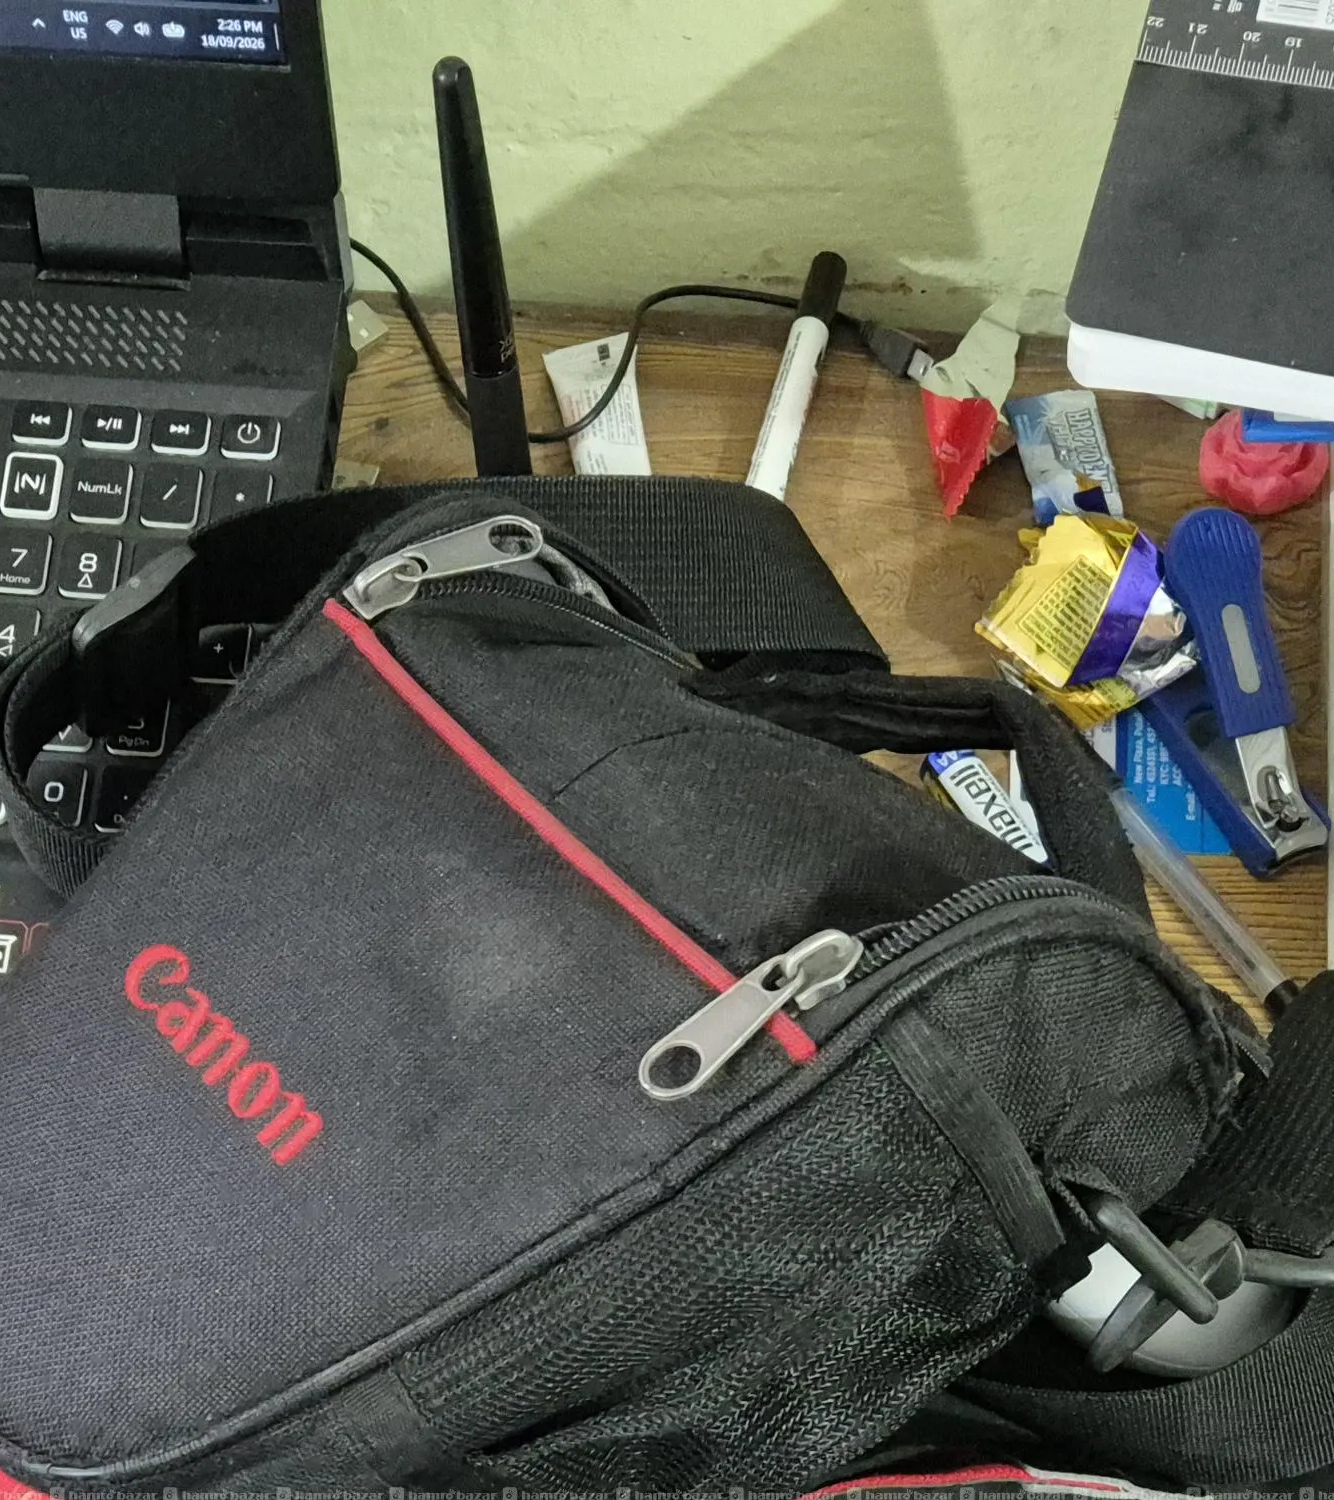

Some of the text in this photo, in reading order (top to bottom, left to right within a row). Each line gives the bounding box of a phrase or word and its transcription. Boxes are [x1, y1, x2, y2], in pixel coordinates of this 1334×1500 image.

[63, 10, 88, 23] ENG
[217, 19, 263, 33] 2:26 PM
[1188, 23, 1208, 34] 21
[70, 27, 87, 39] US
[1243, 31, 1261, 42] 20
[201, 34, 265, 49] 18/09/2026
[1284, 37, 1303, 48] 19
[77, 481, 122, 496] NumLk
[950, 764, 1033, 851] maxell
[125, 944, 324, 1167] Canon
